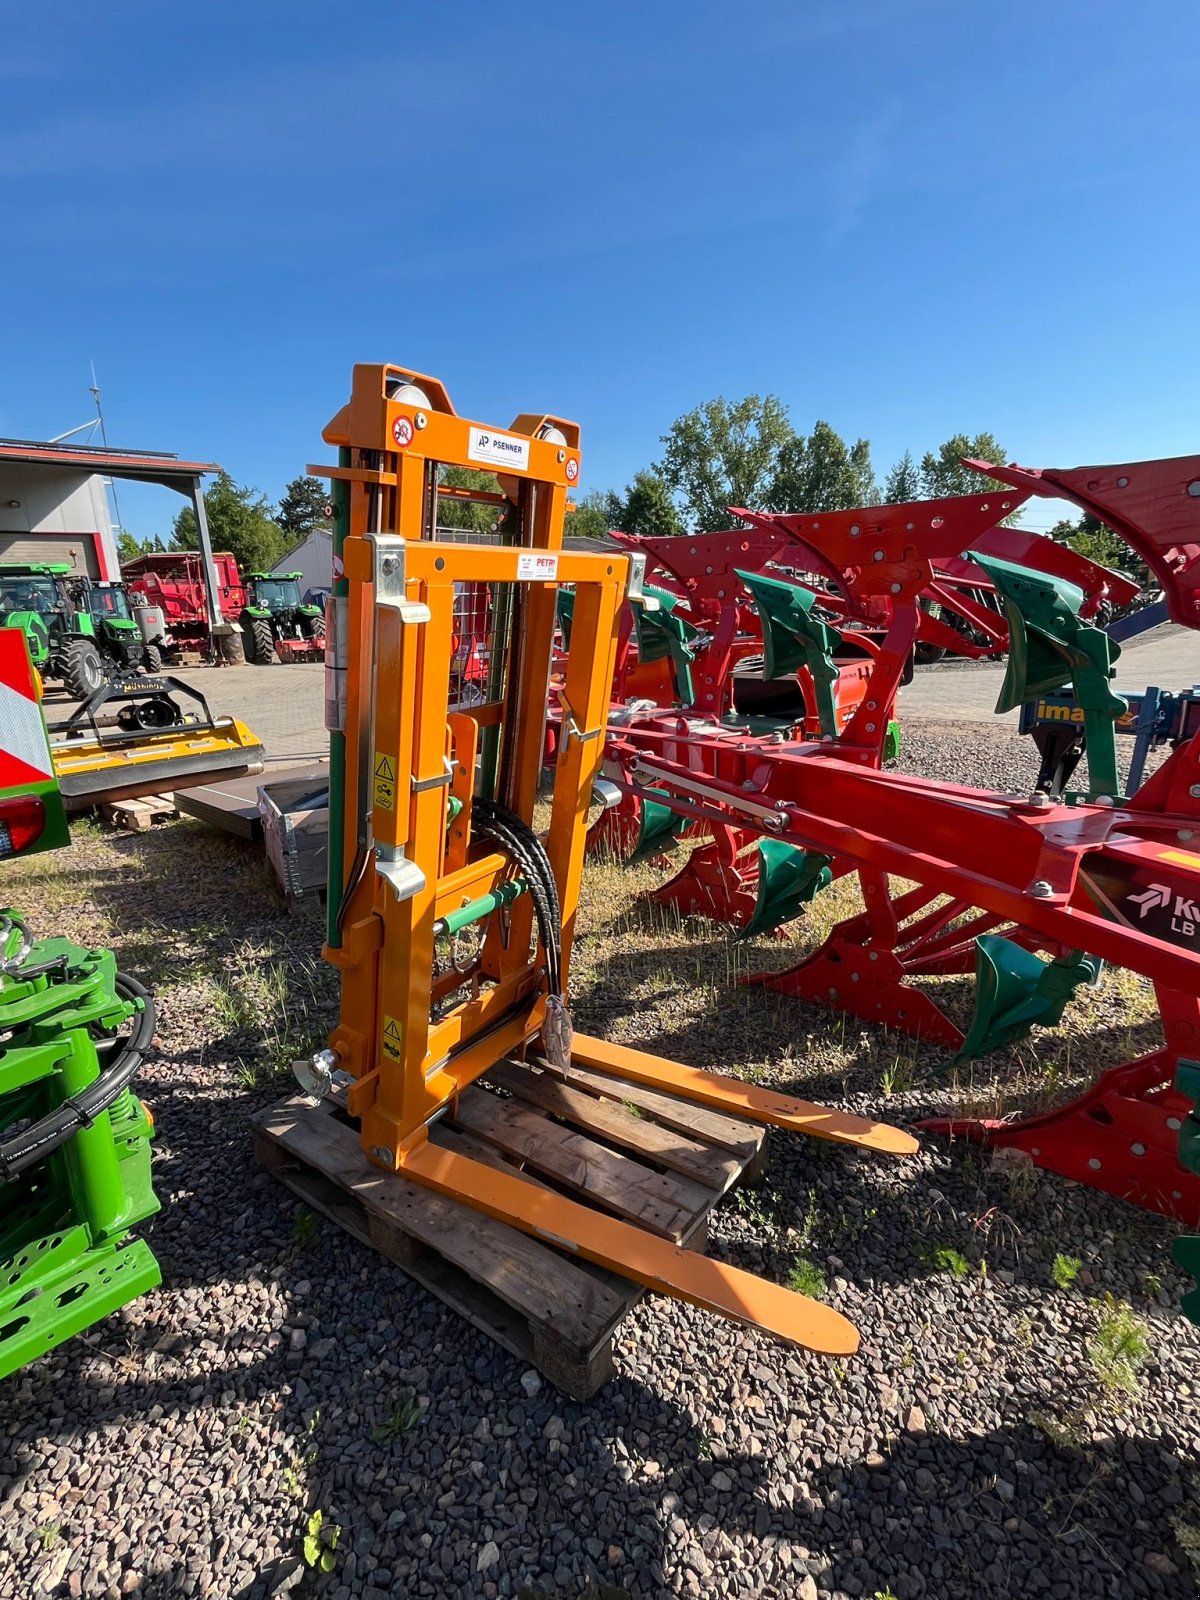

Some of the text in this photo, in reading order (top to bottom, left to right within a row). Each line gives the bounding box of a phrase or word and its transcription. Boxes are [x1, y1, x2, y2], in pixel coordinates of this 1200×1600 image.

[493, 440, 522, 454] PSENNER
[536, 558, 556, 567] PETRI
[1171, 917, 1195, 936] LB
